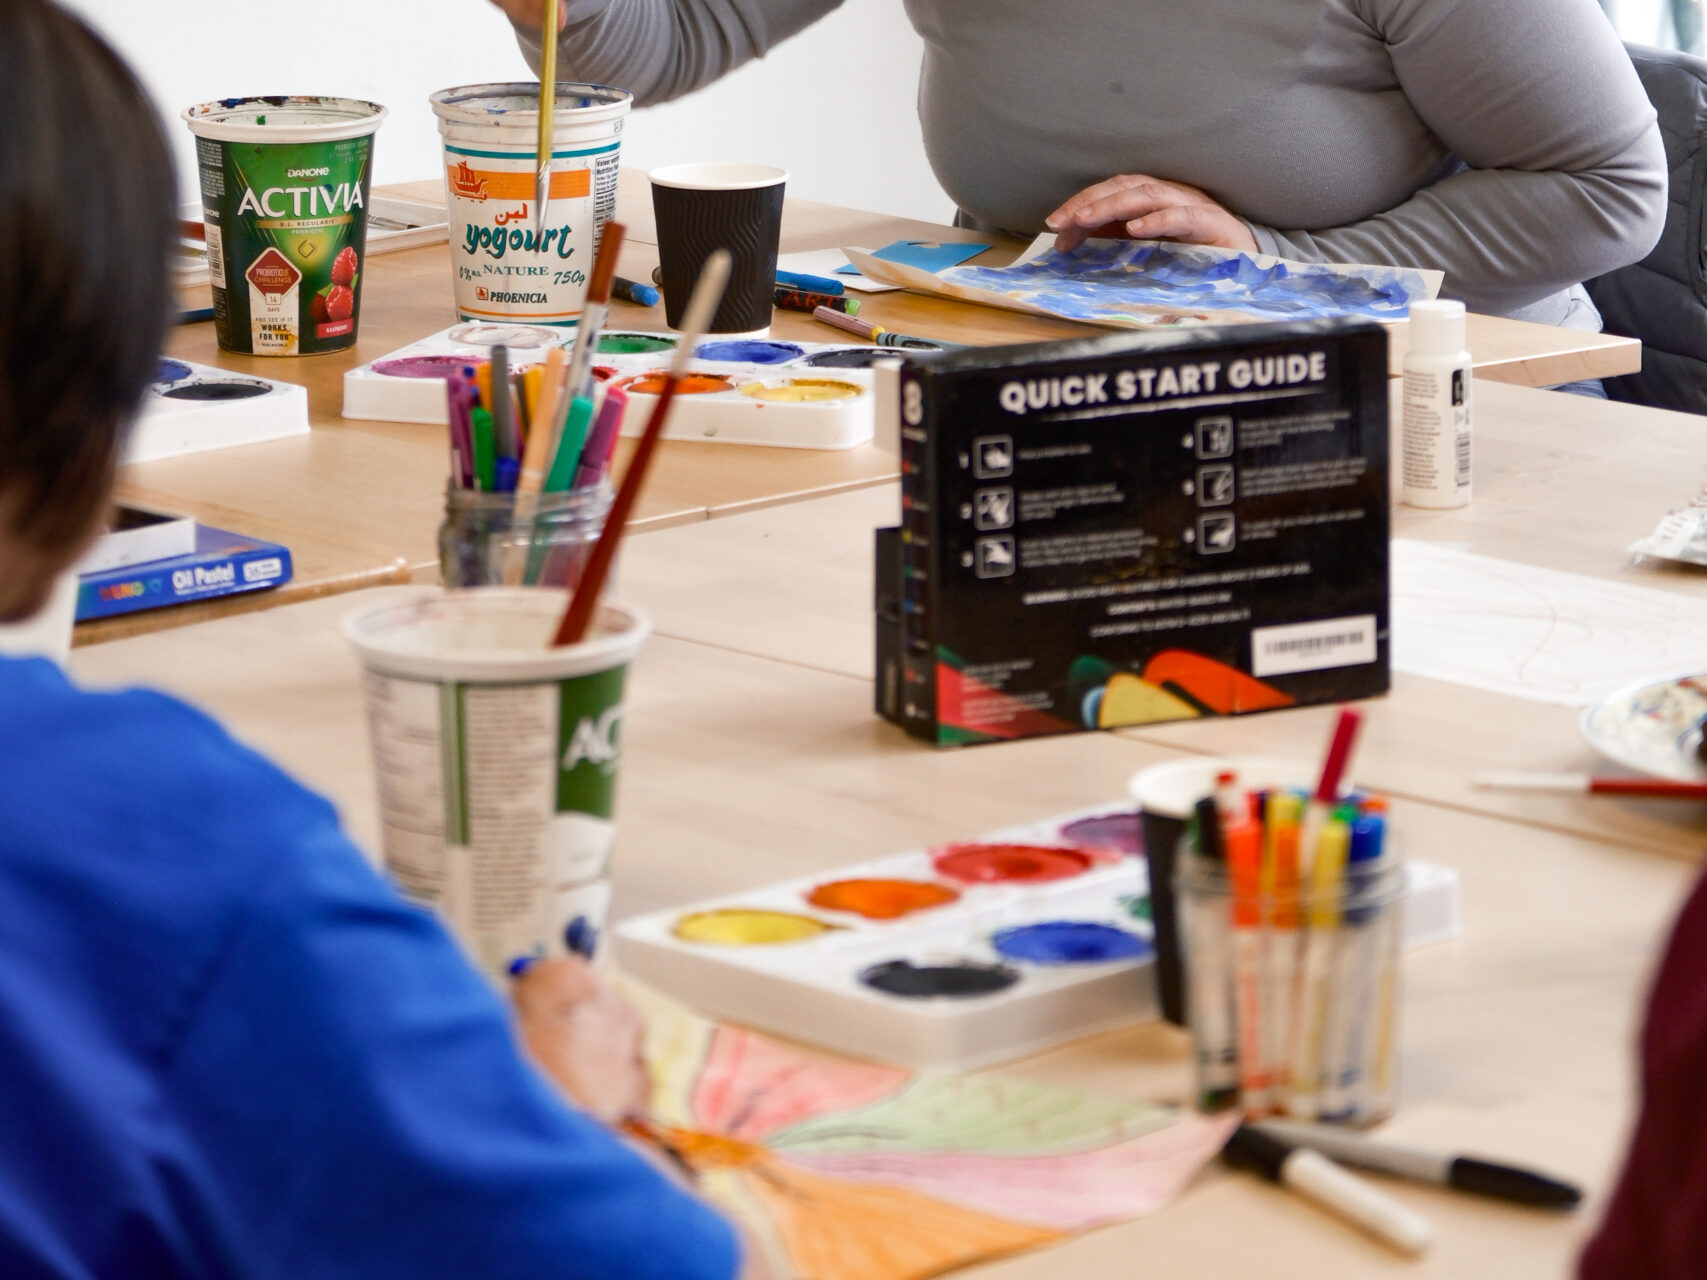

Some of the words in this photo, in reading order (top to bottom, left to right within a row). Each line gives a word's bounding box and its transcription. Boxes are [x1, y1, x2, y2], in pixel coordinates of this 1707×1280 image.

[287, 167, 330, 178] DANONE
[237, 181, 364, 219] ACTIVIA
[494, 202, 528, 226] لبن
[462, 224, 575, 260] yogourt
[483, 264, 550, 277] NATURE
[553, 269, 586, 287] 750g
[490, 291, 548, 304] PHOENICIA
[259, 333, 273, 341] FOR
[261, 324, 288, 332] WORKS
[1000, 373, 1109, 415] QUICK
[1116, 362, 1222, 400] START
[1227, 352, 1327, 390] GUIDE
[172, 569, 194, 589] Oil
[195, 561, 235, 586] Pastel
